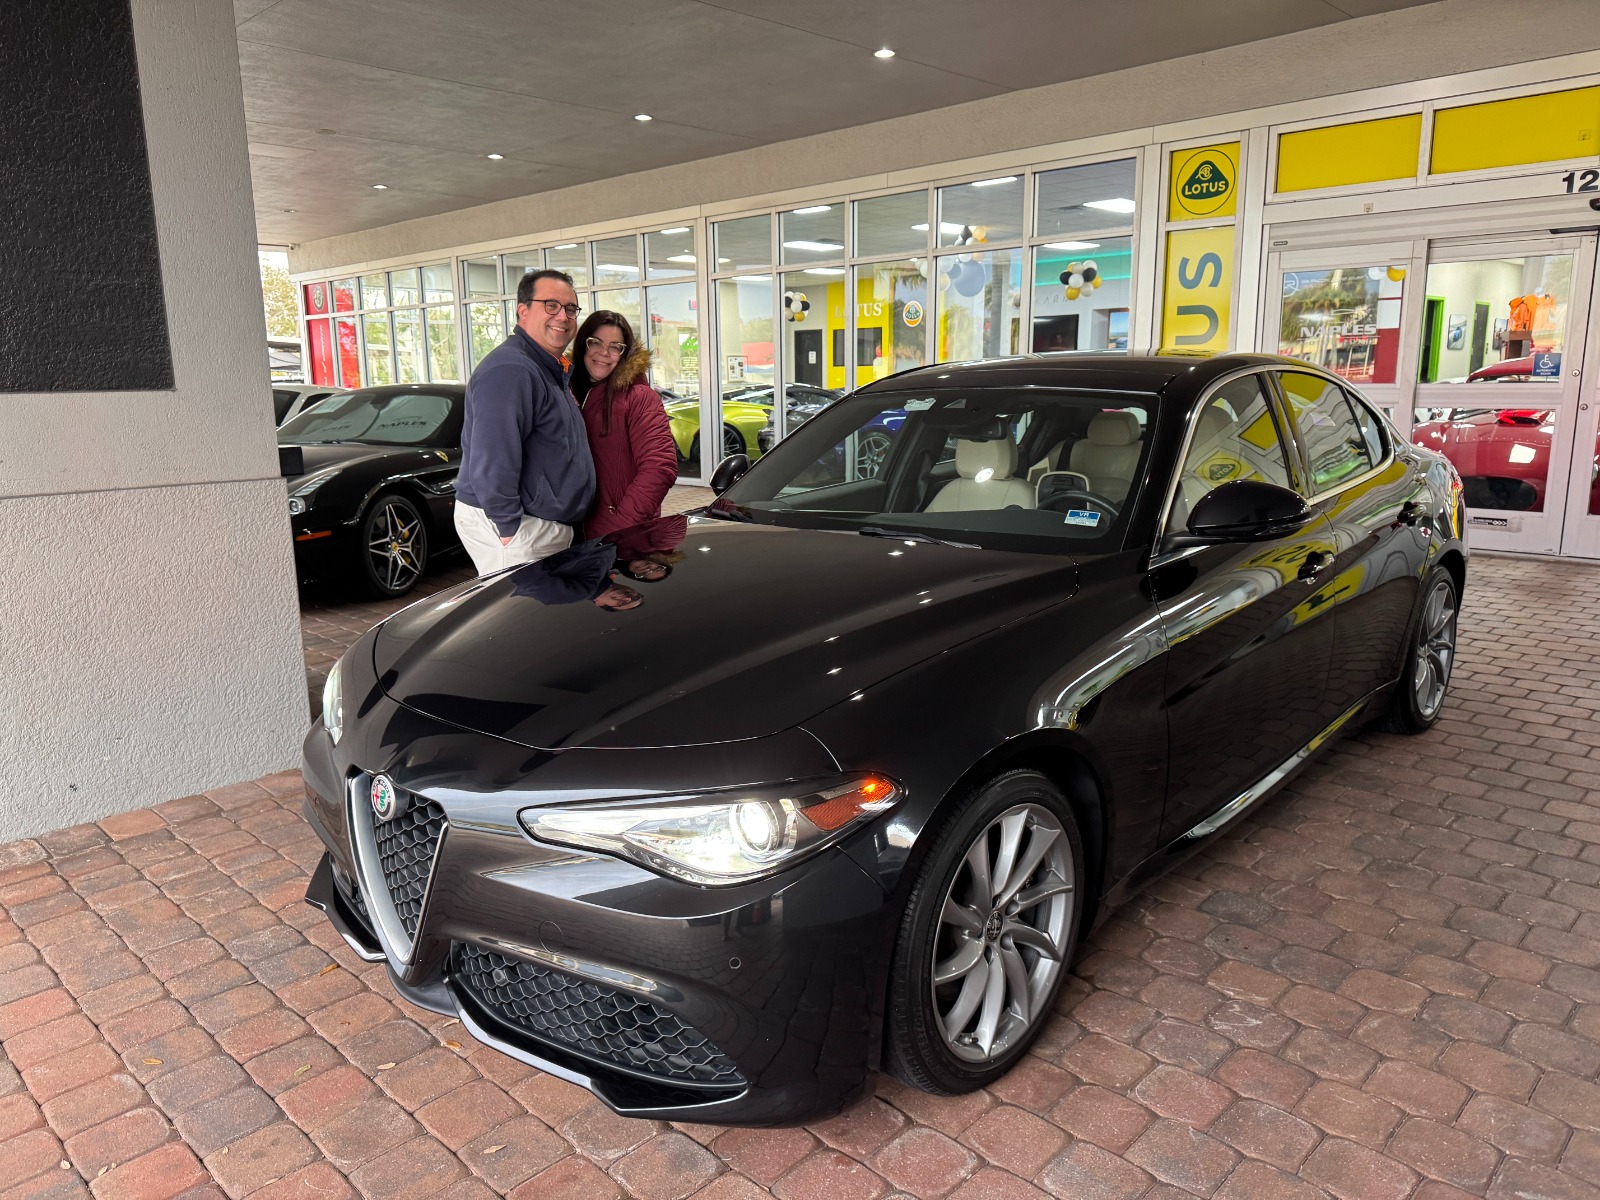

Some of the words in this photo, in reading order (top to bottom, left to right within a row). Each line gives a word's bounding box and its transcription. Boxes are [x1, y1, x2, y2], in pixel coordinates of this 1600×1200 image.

[1184, 180, 1226, 196] LOTUS
[1562, 170, 1600, 193] 12
[1300, 323, 1377, 337] NAPLES
